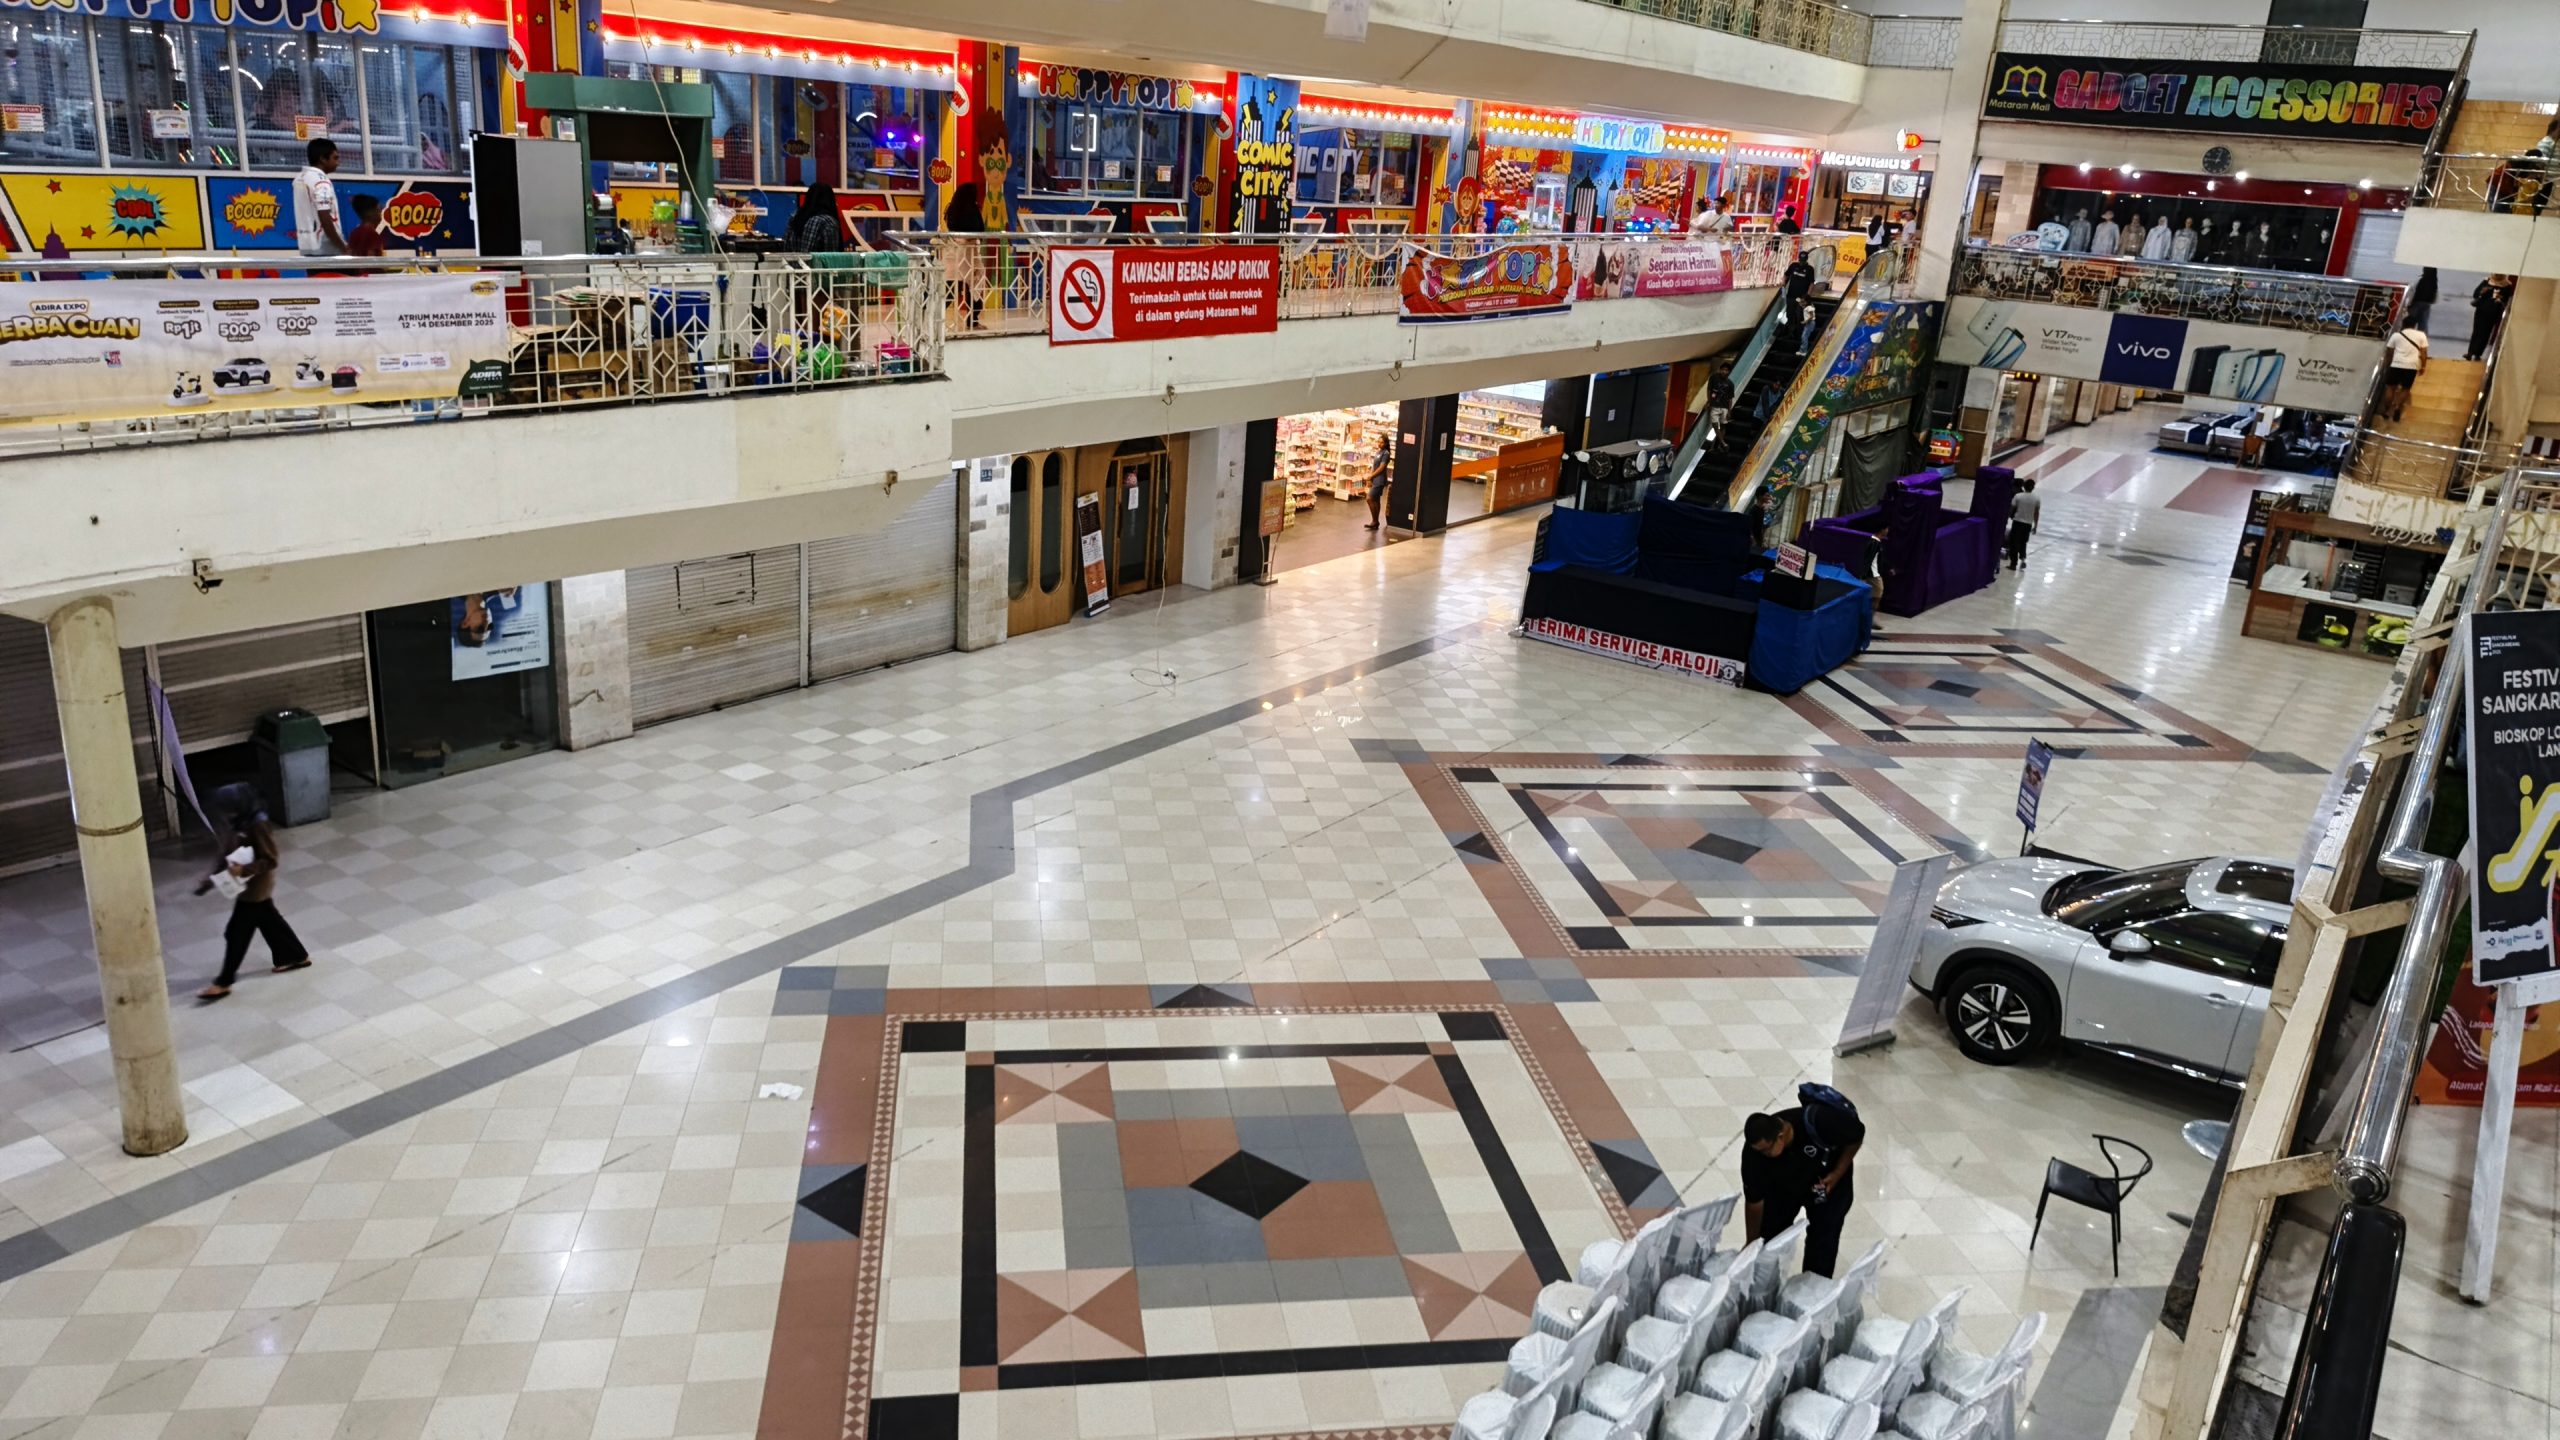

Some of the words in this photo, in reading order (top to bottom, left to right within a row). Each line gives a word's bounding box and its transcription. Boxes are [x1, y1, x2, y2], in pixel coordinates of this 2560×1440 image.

[1988, 99, 2029, 111] Mataram
[2030, 101, 2051, 112] Mall
[2053, 69, 2187, 115] GADGET
[2185, 75, 2443, 129] ACCESSORIES
[1237, 139, 1293, 167] COMIC
[1240, 171, 1285, 196] CITY
[115, 199, 157, 219] COOL
[225, 202, 281, 222] BOOOM!
[389, 203, 441, 227] BOO!!
[1122, 261, 1175, 284] KAWASAN
[1177, 261, 1210, 283] BEBAS
[1211, 260, 1237, 281] ASAP
[1238, 259, 1271, 280] ROKOK
[1648, 257, 1688, 276] Segarkan
[1129, 289, 1181, 304] Terimakasih
[1183, 290, 1206, 302] untuk
[1208, 288, 1228, 301] tidak
[1230, 287, 1263, 300] merokok
[35, 303, 62, 312] ADIRA
[64, 303, 87, 311] EXPO
[1135, 310, 1143, 322] di
[1145, 309, 1172, 321] dalam
[1174, 308, 1204, 323] gedung
[1206, 306, 1239, 319] Mataram
[1241, 305, 1258, 317] Mall
[398, 314, 431, 322] ATRIUM
[432, 313, 473, 321] MATARAM
[429, 320, 472, 328] DESEMBER
[0, 313, 66, 345] ERBA
[2118, 341, 2170, 359] vivo
[469, 371, 503, 379] ADIRA
[1528, 617, 1586, 643] TERIMA
[1589, 628, 1658, 661] SERVICE
[1661, 649, 1720, 676] ARLOJI
[2503, 668, 2560, 689] FESTIV
[2482, 692, 2560, 714] SANGKAR
[2494, 727, 2545, 744] BIOSKOP
[2547, 725, 2560, 740] LO
[2538, 745, 2560, 758] LAN
[2449, 1081, 2483, 1091] Alamat
